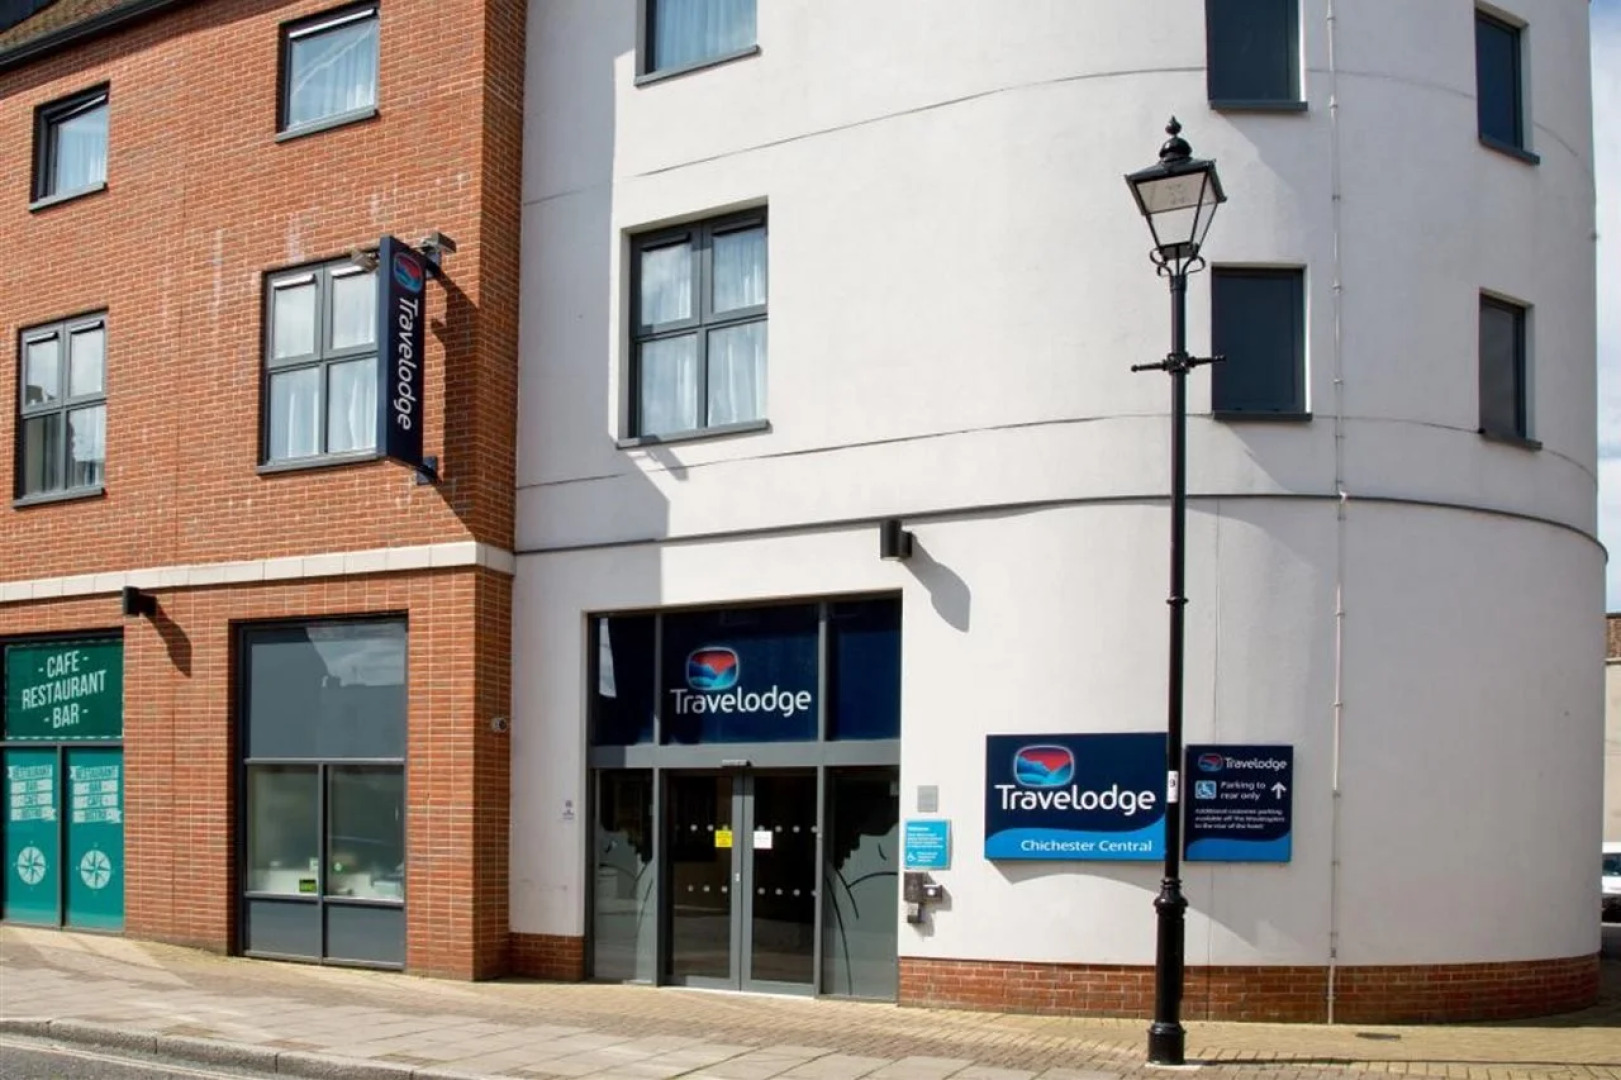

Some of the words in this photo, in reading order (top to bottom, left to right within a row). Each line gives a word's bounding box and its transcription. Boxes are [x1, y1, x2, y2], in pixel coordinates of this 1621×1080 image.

[393, 297, 419, 430] Travelodge
[22, 669, 107, 710] RESTAURANT
[669, 685, 812, 718] Travelodge
[1224, 757, 1288, 772] Travelodge
[1220, 781, 1255, 791] Parking
[1256, 781, 1266, 790] to
[1220, 792, 1240, 800] rear
[1240, 791, 1261, 801] only
[994, 783, 1156, 816] Travelodge
[1021, 839, 1095, 852] Chichester
[1098, 839, 1152, 852] Central
